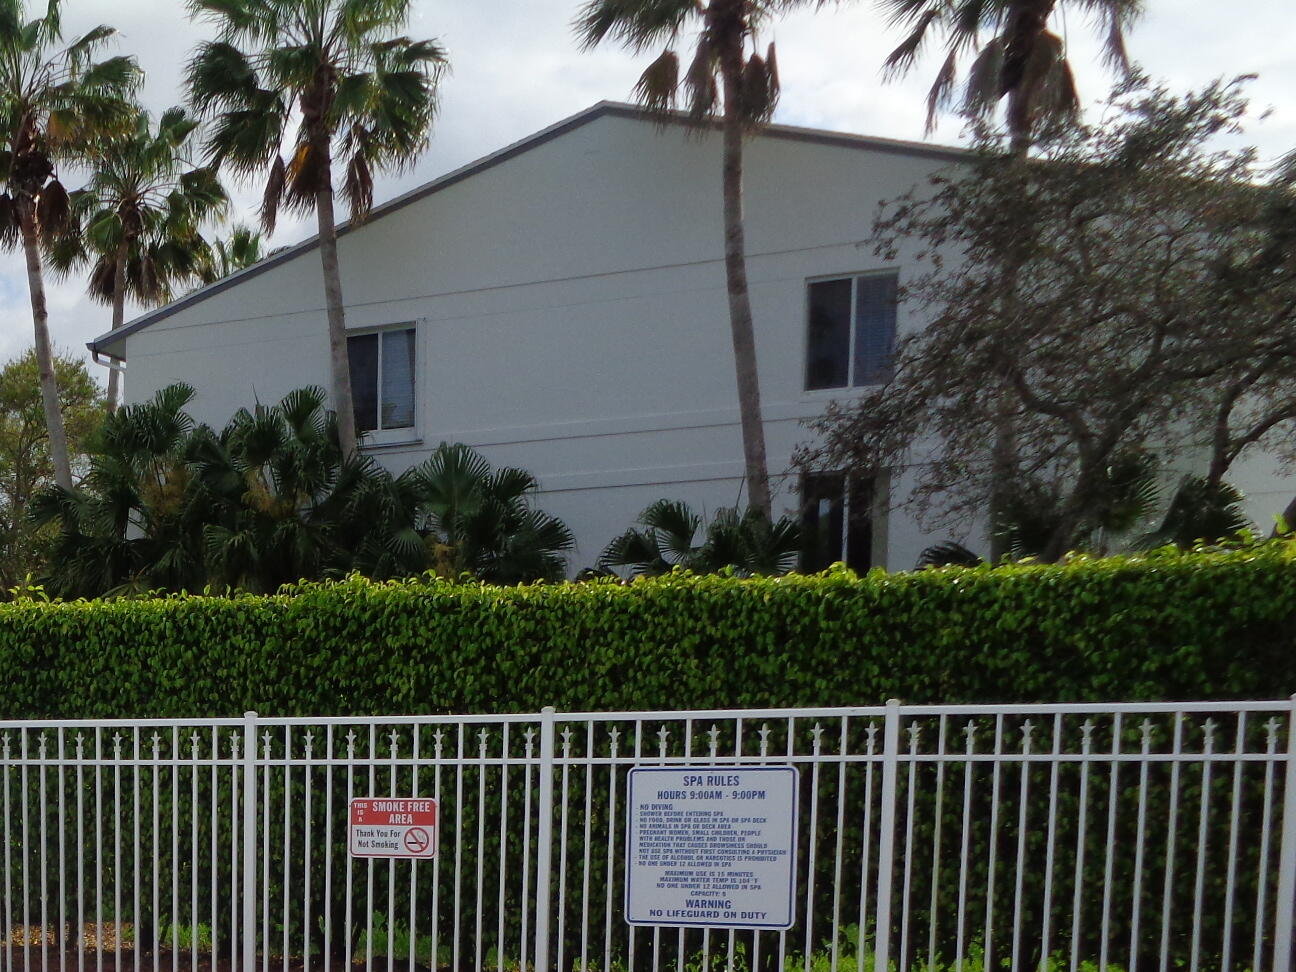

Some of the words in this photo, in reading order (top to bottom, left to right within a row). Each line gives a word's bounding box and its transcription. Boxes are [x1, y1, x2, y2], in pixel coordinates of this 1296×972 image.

[683, 776, 703, 786] SPA
[707, 776, 740, 786] RULES
[658, 791, 686, 799] HOURS
[690, 791, 722, 799] 9:00AM
[732, 791, 766, 799] 9:00PM
[372, 802, 404, 812] SMOKE
[408, 802, 430, 812] FREE
[389, 814, 413, 824] AREA
[371, 841, 398, 850] Smoking
[686, 900, 731, 909] WARNING
